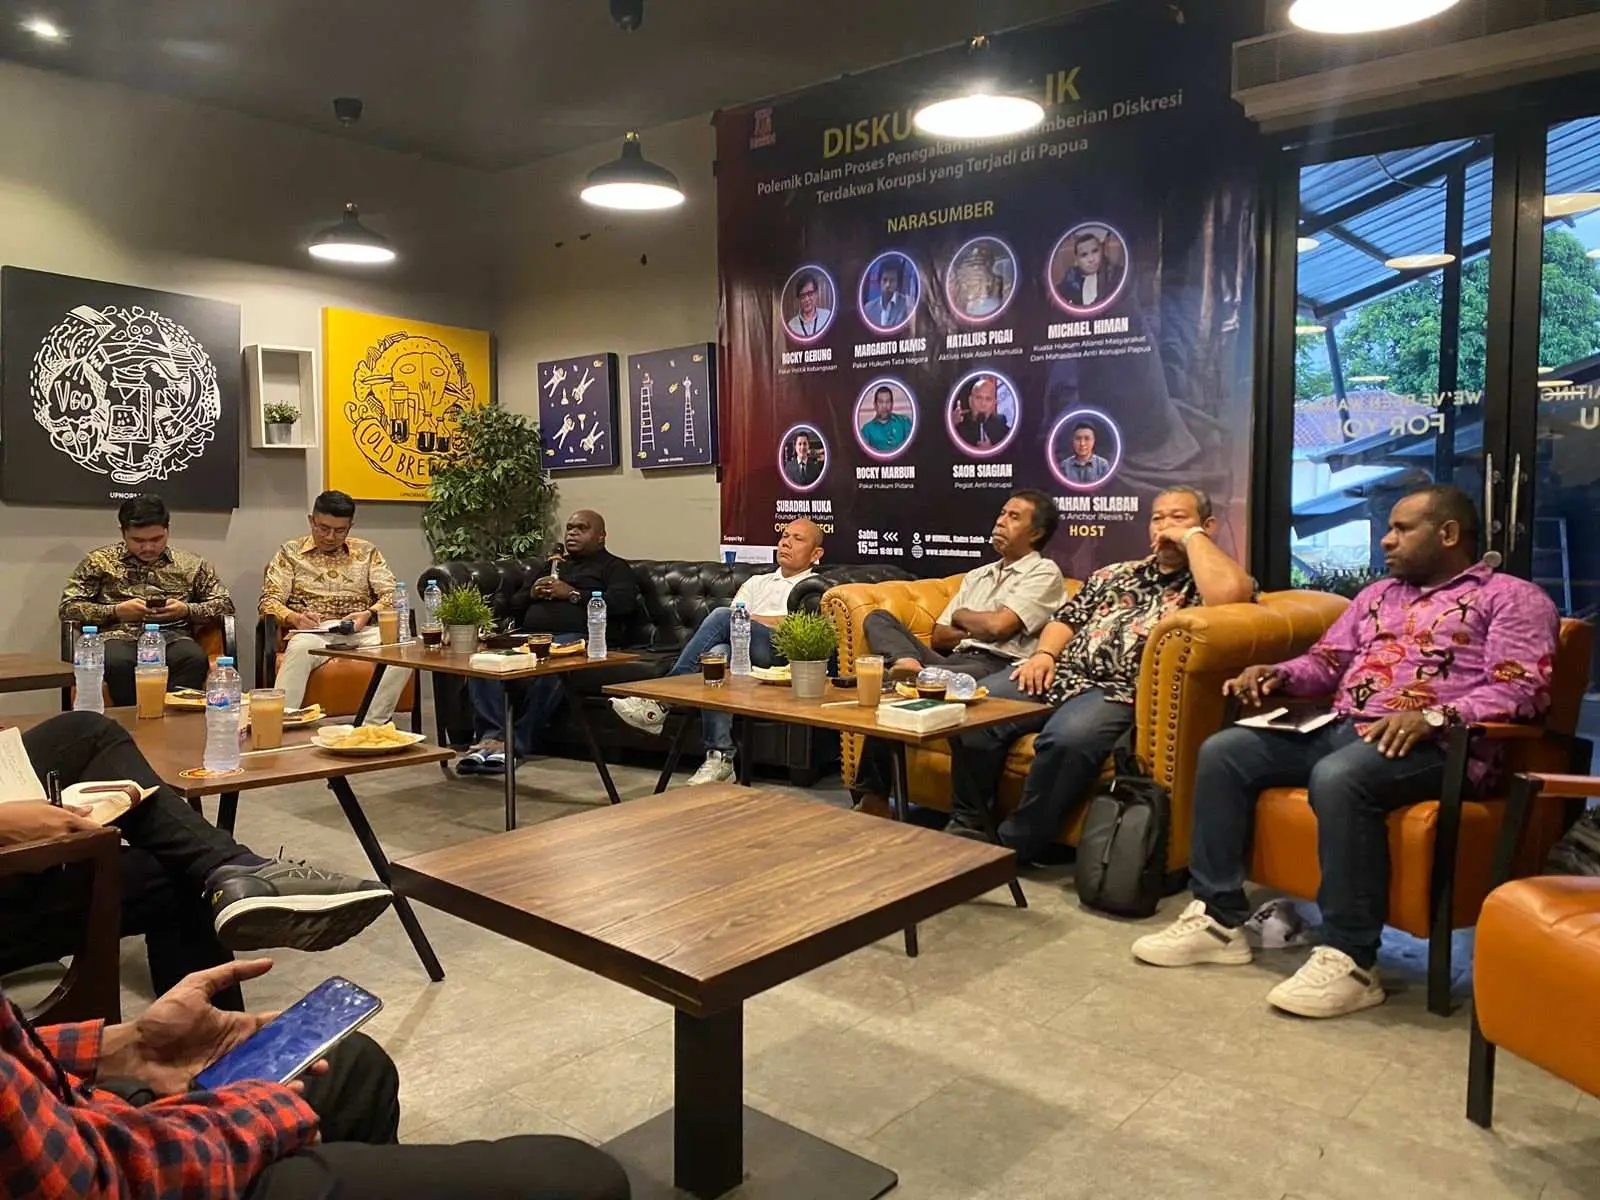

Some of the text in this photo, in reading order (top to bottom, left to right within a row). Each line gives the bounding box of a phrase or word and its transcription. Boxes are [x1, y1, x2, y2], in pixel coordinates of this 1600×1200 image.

[757, 175, 802, 195] Polemik
[804, 166, 842, 186] Dalam
[845, 156, 885, 180] Proses
[887, 140, 962, 167] Penegakan
[1034, 106, 1109, 134] mberian
[1112, 89, 1183, 119] Diskresi
[823, 108, 924, 159] DISKU
[816, 182, 874, 204] Terdakwa
[877, 171, 926, 192] Korupsi
[929, 162, 963, 184] yang
[966, 149, 1017, 173] Terjadi
[1020, 146, 1035, 162] di
[1038, 137, 1089, 159] Papua
[887, 200, 995, 233] NARASUMBER
[1047, 316, 1129, 340] MICHAEL HIMAN
[854, 337, 926, 358] MARGARITO KAMIS
[946, 329, 1013, 349] NATALIUS PIGAI
[782, 348, 832, 365] ROCKY GERUNG
[360, 423, 394, 463] COLD
[881, 466, 915, 479] MARBUN
[952, 463, 1013, 478] SAOR SIAGIAN
[776, 500, 832, 513] SUBADRIA NUKA
[1053, 496, 1139, 512] AHAM SILABAN
[1066, 512, 1097, 521] Anchor
[858, 529, 878, 540] Sabtu
[1069, 524, 1106, 537] HOST
[857, 540, 868, 555] 15
